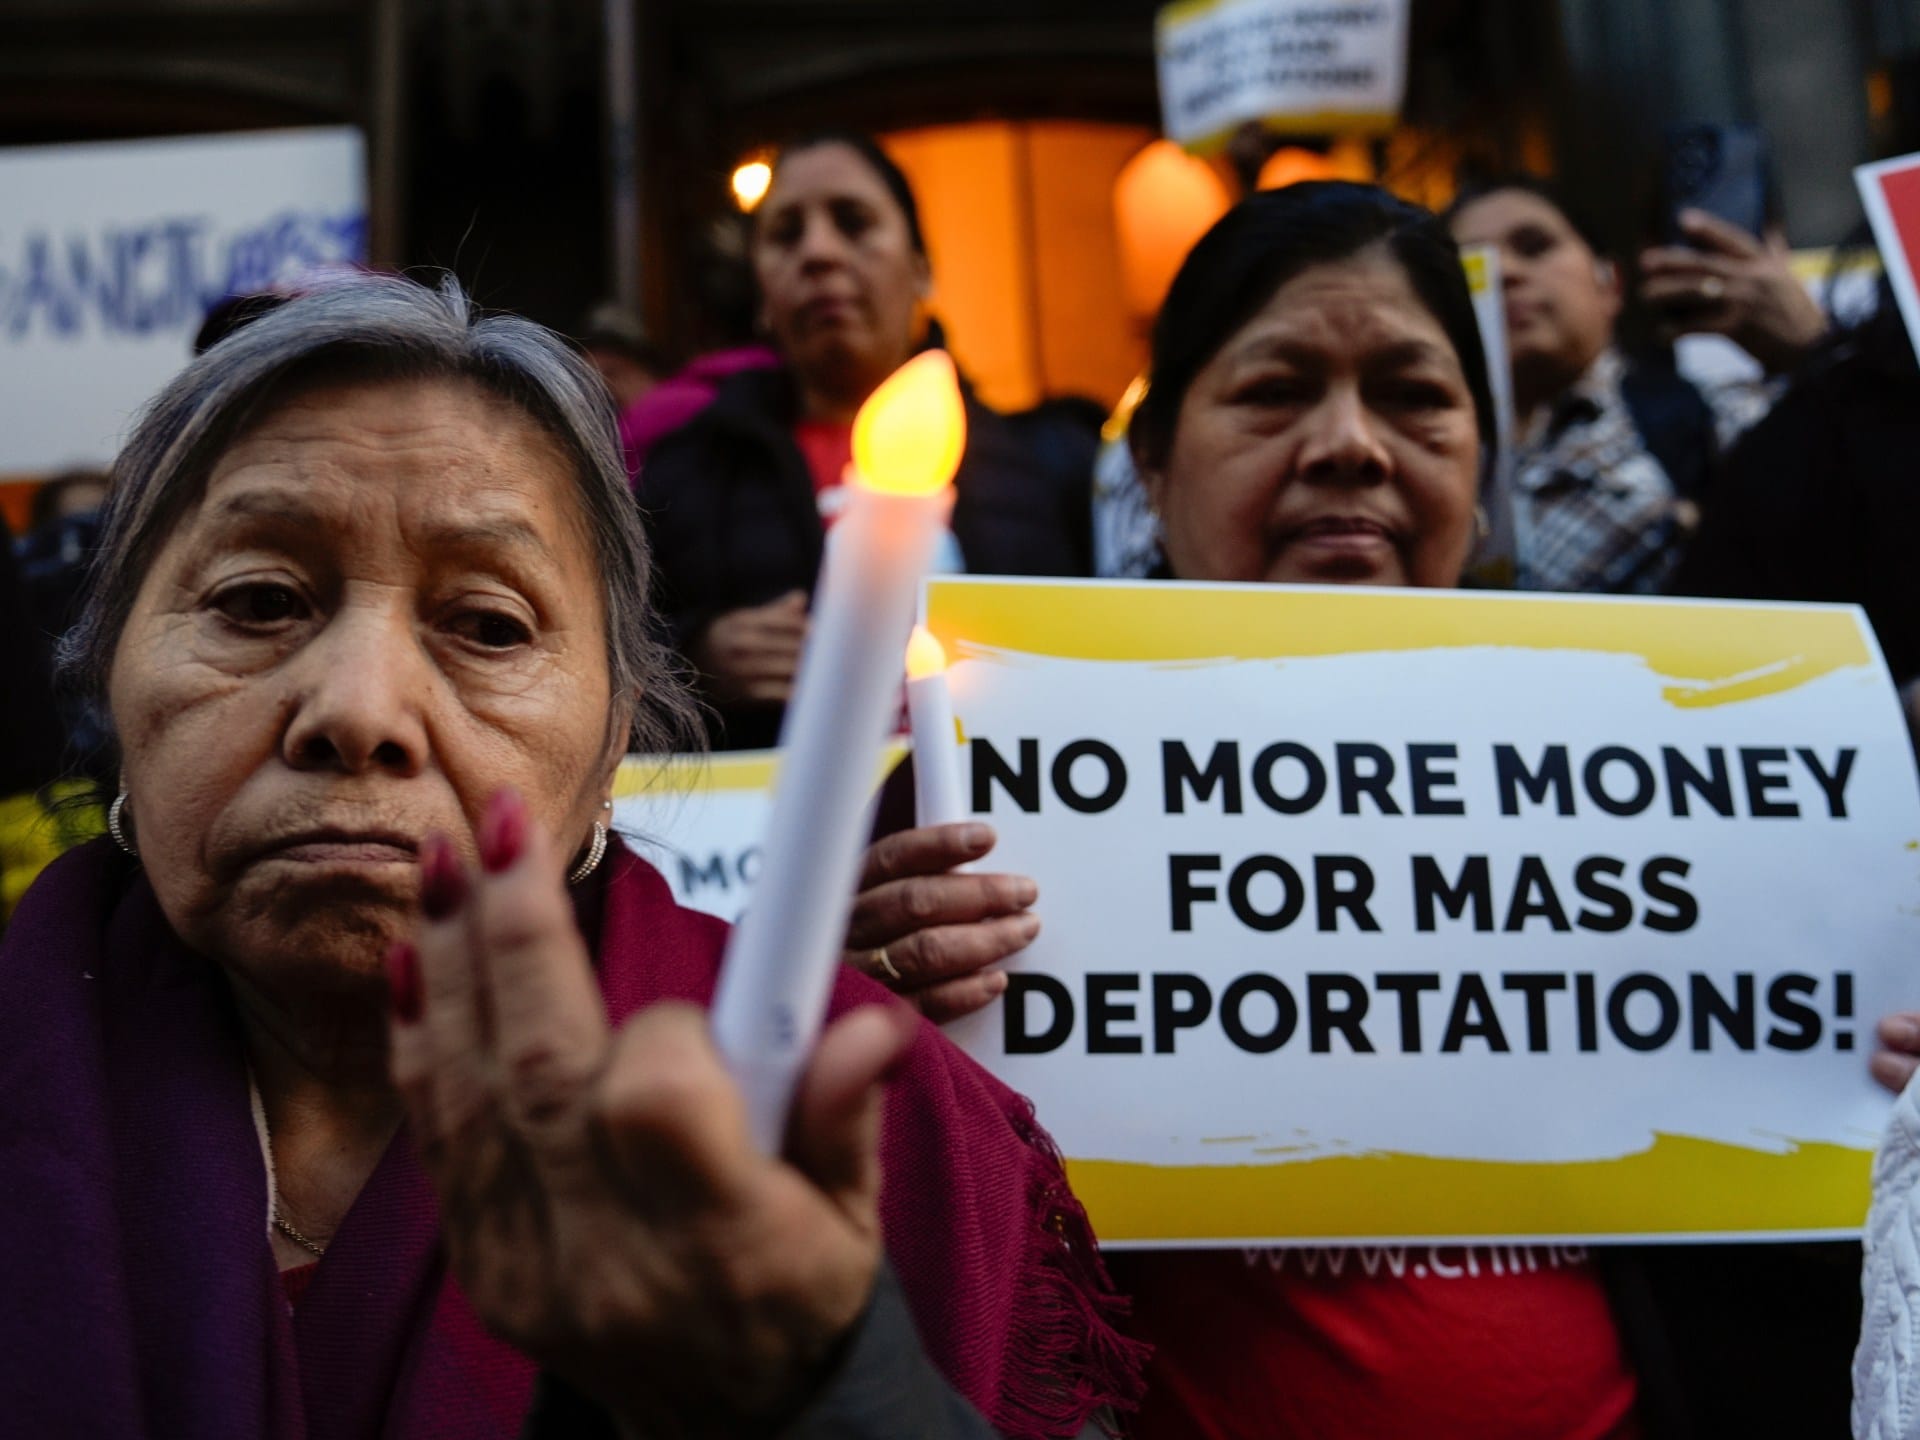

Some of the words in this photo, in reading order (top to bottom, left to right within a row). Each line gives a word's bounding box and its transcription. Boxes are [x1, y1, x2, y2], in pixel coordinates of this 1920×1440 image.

[970, 737, 1128, 814] NO
[1160, 740, 1466, 816] MORE
[1492, 744, 1857, 819] MONEY
[1167, 853, 1382, 933] FOR
[1410, 855, 1699, 934] MASS
[1003, 972, 1856, 1055] DEPORTATIONS!
